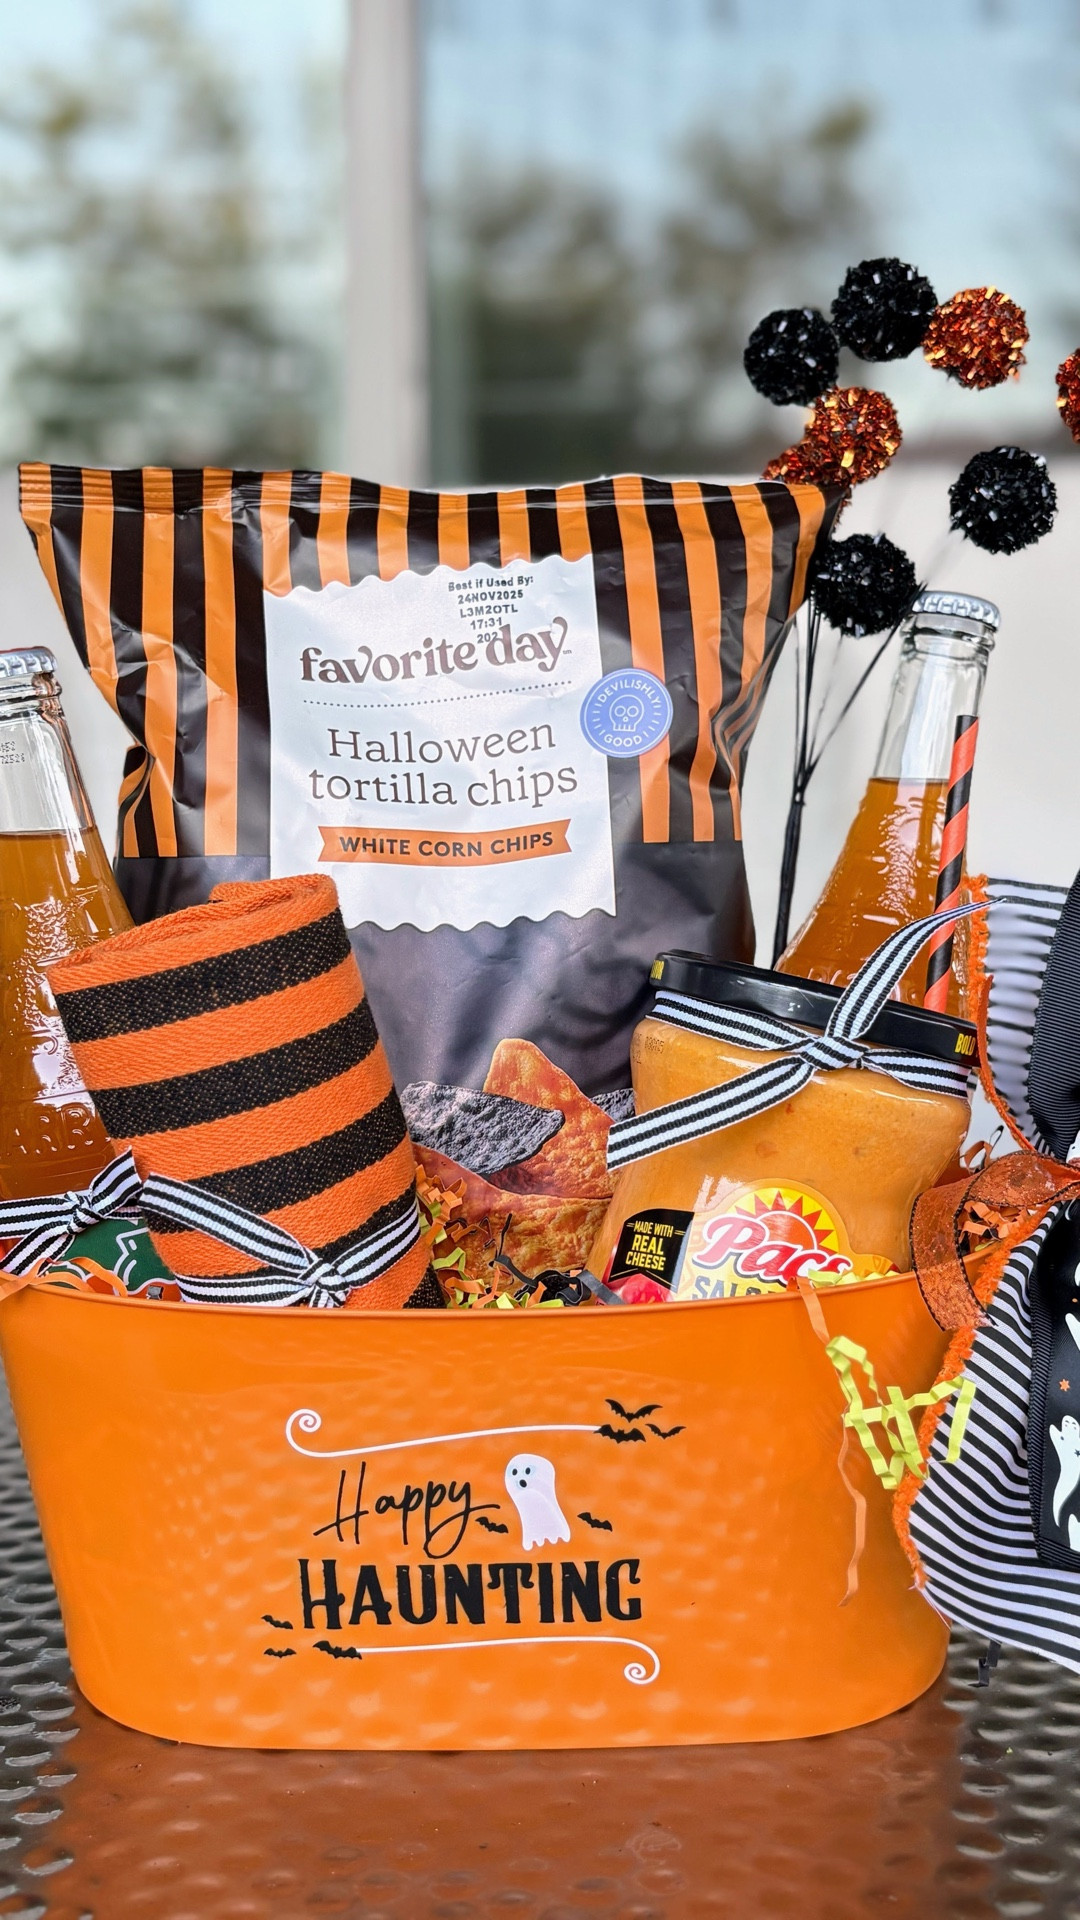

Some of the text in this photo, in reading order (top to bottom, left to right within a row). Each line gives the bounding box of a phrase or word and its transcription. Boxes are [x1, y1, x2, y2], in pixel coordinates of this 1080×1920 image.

[448, 575, 534, 592] Best if Used By:
[457, 589, 524, 605] 24NOV2025
[470, 617, 502, 630] 17:31
[300, 637, 478, 684] favorite
[485, 616, 569, 673] day
[597, 679, 661, 704] DEVILISHLY
[327, 723, 556, 763] Halloween
[603, 734, 642, 747] GOOD
[309, 766, 578, 808] tortilla chips
[339, 831, 554, 858] WHITE CORN CHIPS
[955, 1033, 976, 1056] BOLD
[633, 1220, 674, 1238] MADE WITH
[631, 1234, 664, 1255] REAL
[625, 1251, 667, 1271] CHEESE
[313, 1461, 500, 1559] Happy
[298, 1558, 642, 1629] HAUNTING
